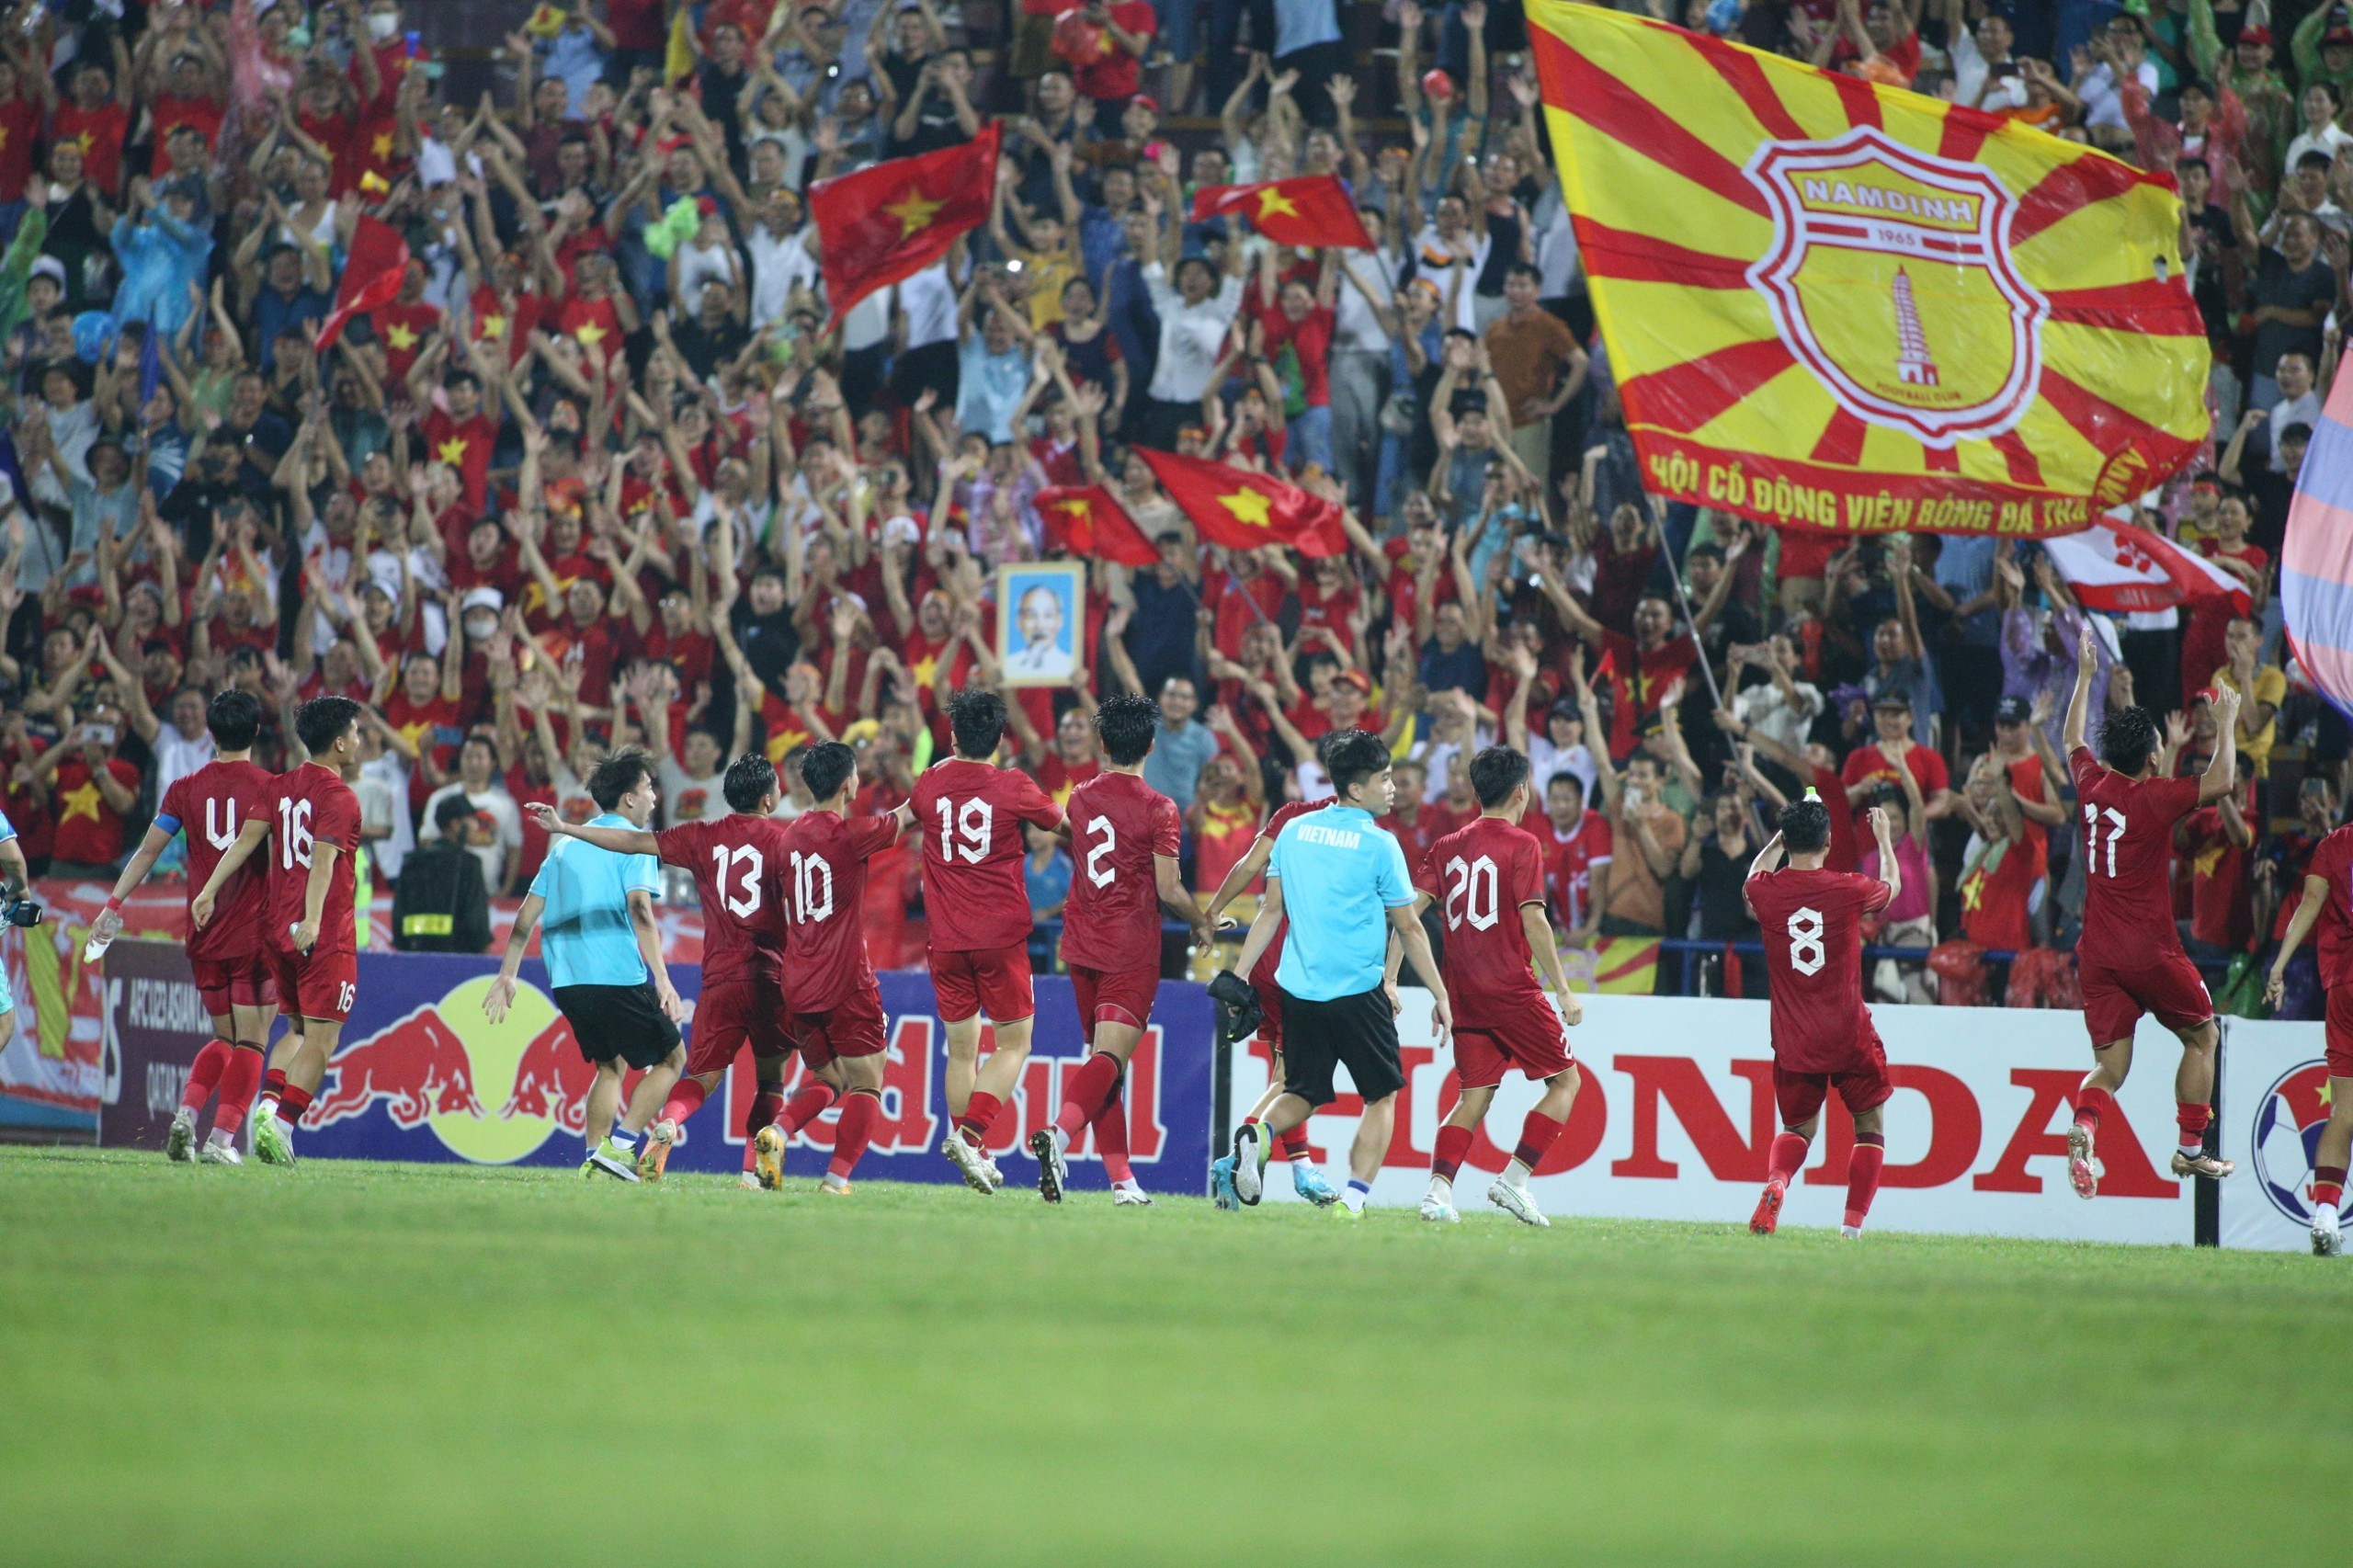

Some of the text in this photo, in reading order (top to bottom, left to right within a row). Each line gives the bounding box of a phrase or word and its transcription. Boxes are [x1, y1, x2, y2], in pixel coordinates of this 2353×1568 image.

[1802, 178, 1973, 222] NAMDINH
[1878, 229, 1915, 245] 1965
[1752, 475, 1836, 528] ĐỘNG
[1845, 490, 1914, 529] VIÊN
[206, 797, 236, 851] 4
[278, 796, 313, 870] 16
[936, 796, 993, 864] 19
[1086, 814, 1116, 889] 2
[1297, 824, 1361, 849] VIETNAM
[2085, 802, 2126, 878] 17
[712, 844, 763, 918] 13
[790, 850, 833, 925] 10
[1445, 855, 1498, 931] 20
[1788, 906, 1825, 976] 8
[336, 981, 356, 1013] 16
[1247, 1040, 2180, 1199] HONDA
